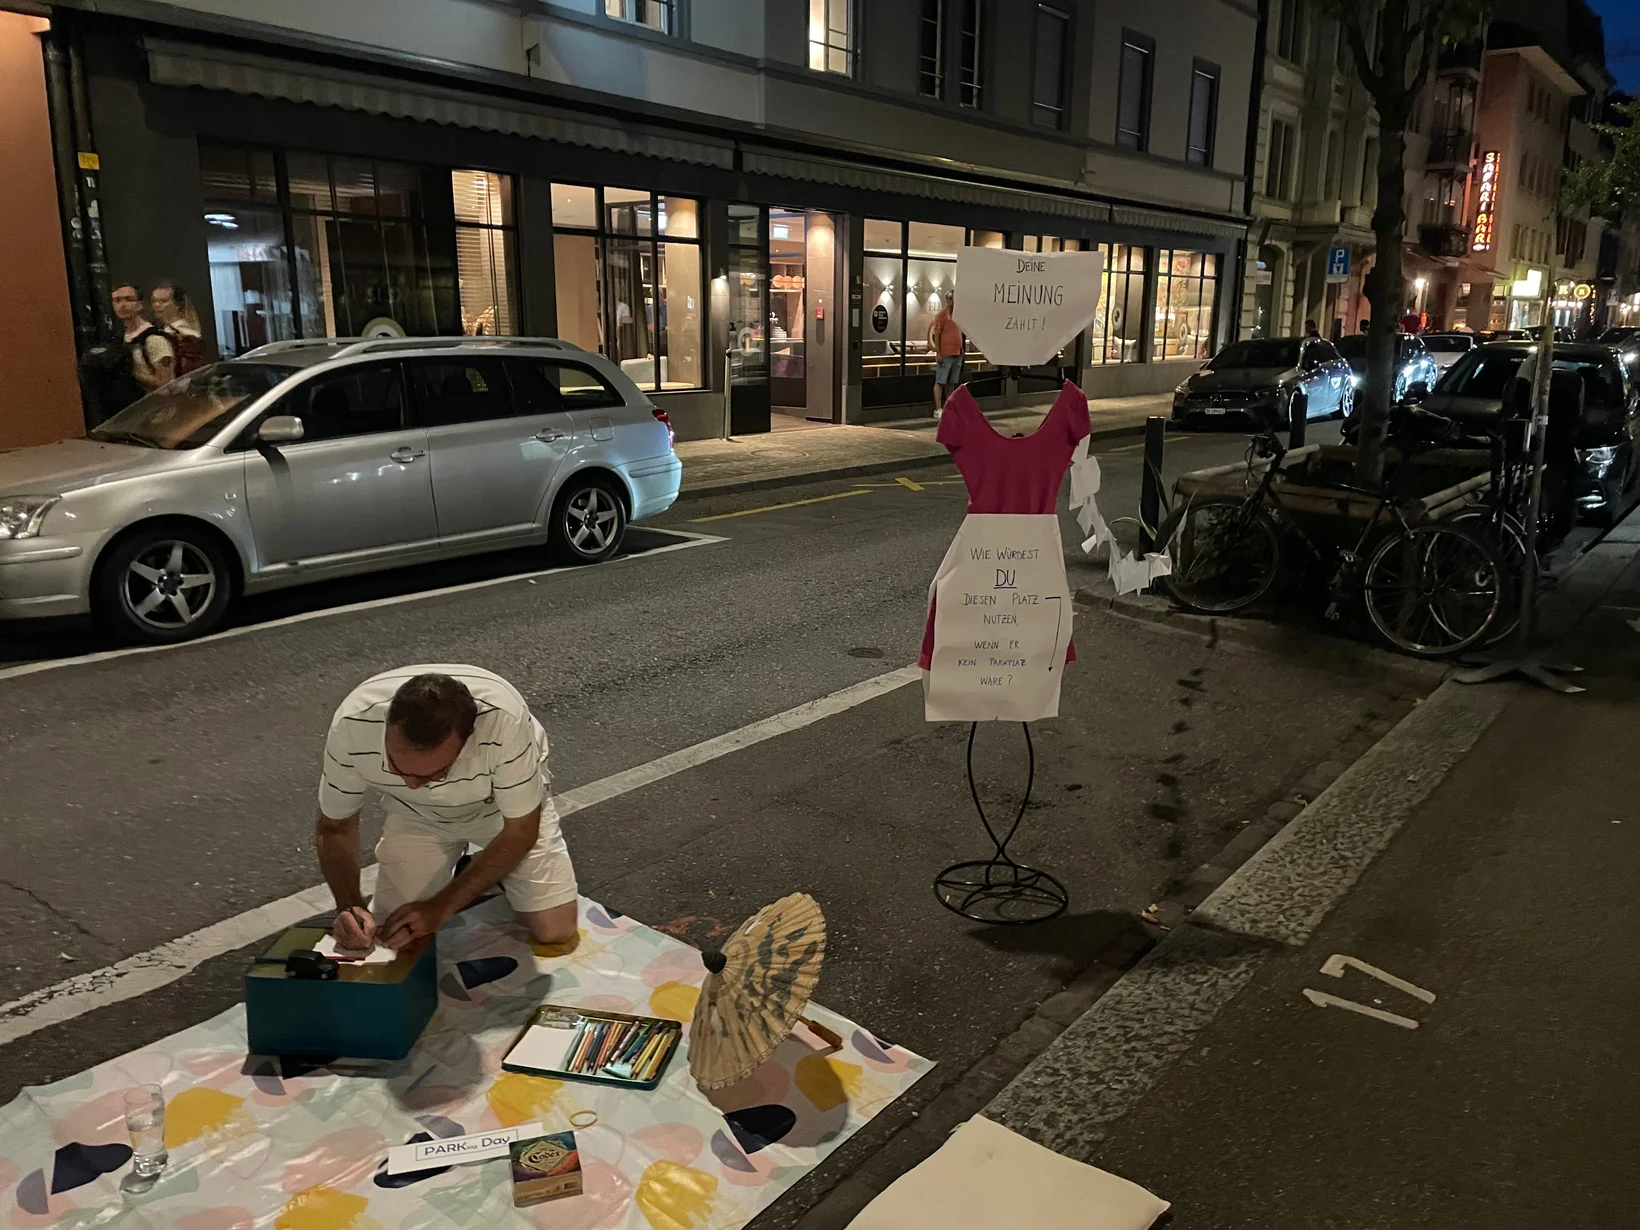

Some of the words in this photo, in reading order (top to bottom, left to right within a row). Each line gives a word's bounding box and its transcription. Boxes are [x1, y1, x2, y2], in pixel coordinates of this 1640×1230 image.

[1479, 152, 1495, 211] SAFARI
[1475, 213, 1488, 244] BAR
[1335, 249, 1345, 263] P
[1016, 258, 1046, 274] DEINE
[994, 280, 1064, 306] MEINUNG
[970, 547, 992, 560] WIE
[994, 568, 1016, 587] DU
[960, 592, 997, 606] DIESEN
[1012, 592, 1039, 606] PLATZ
[974, 640, 1000, 650] WENN
[1009, 640, 1020, 650] ER
[958, 658, 977, 667] KEIN
[482, 1137, 510, 1148] Day
